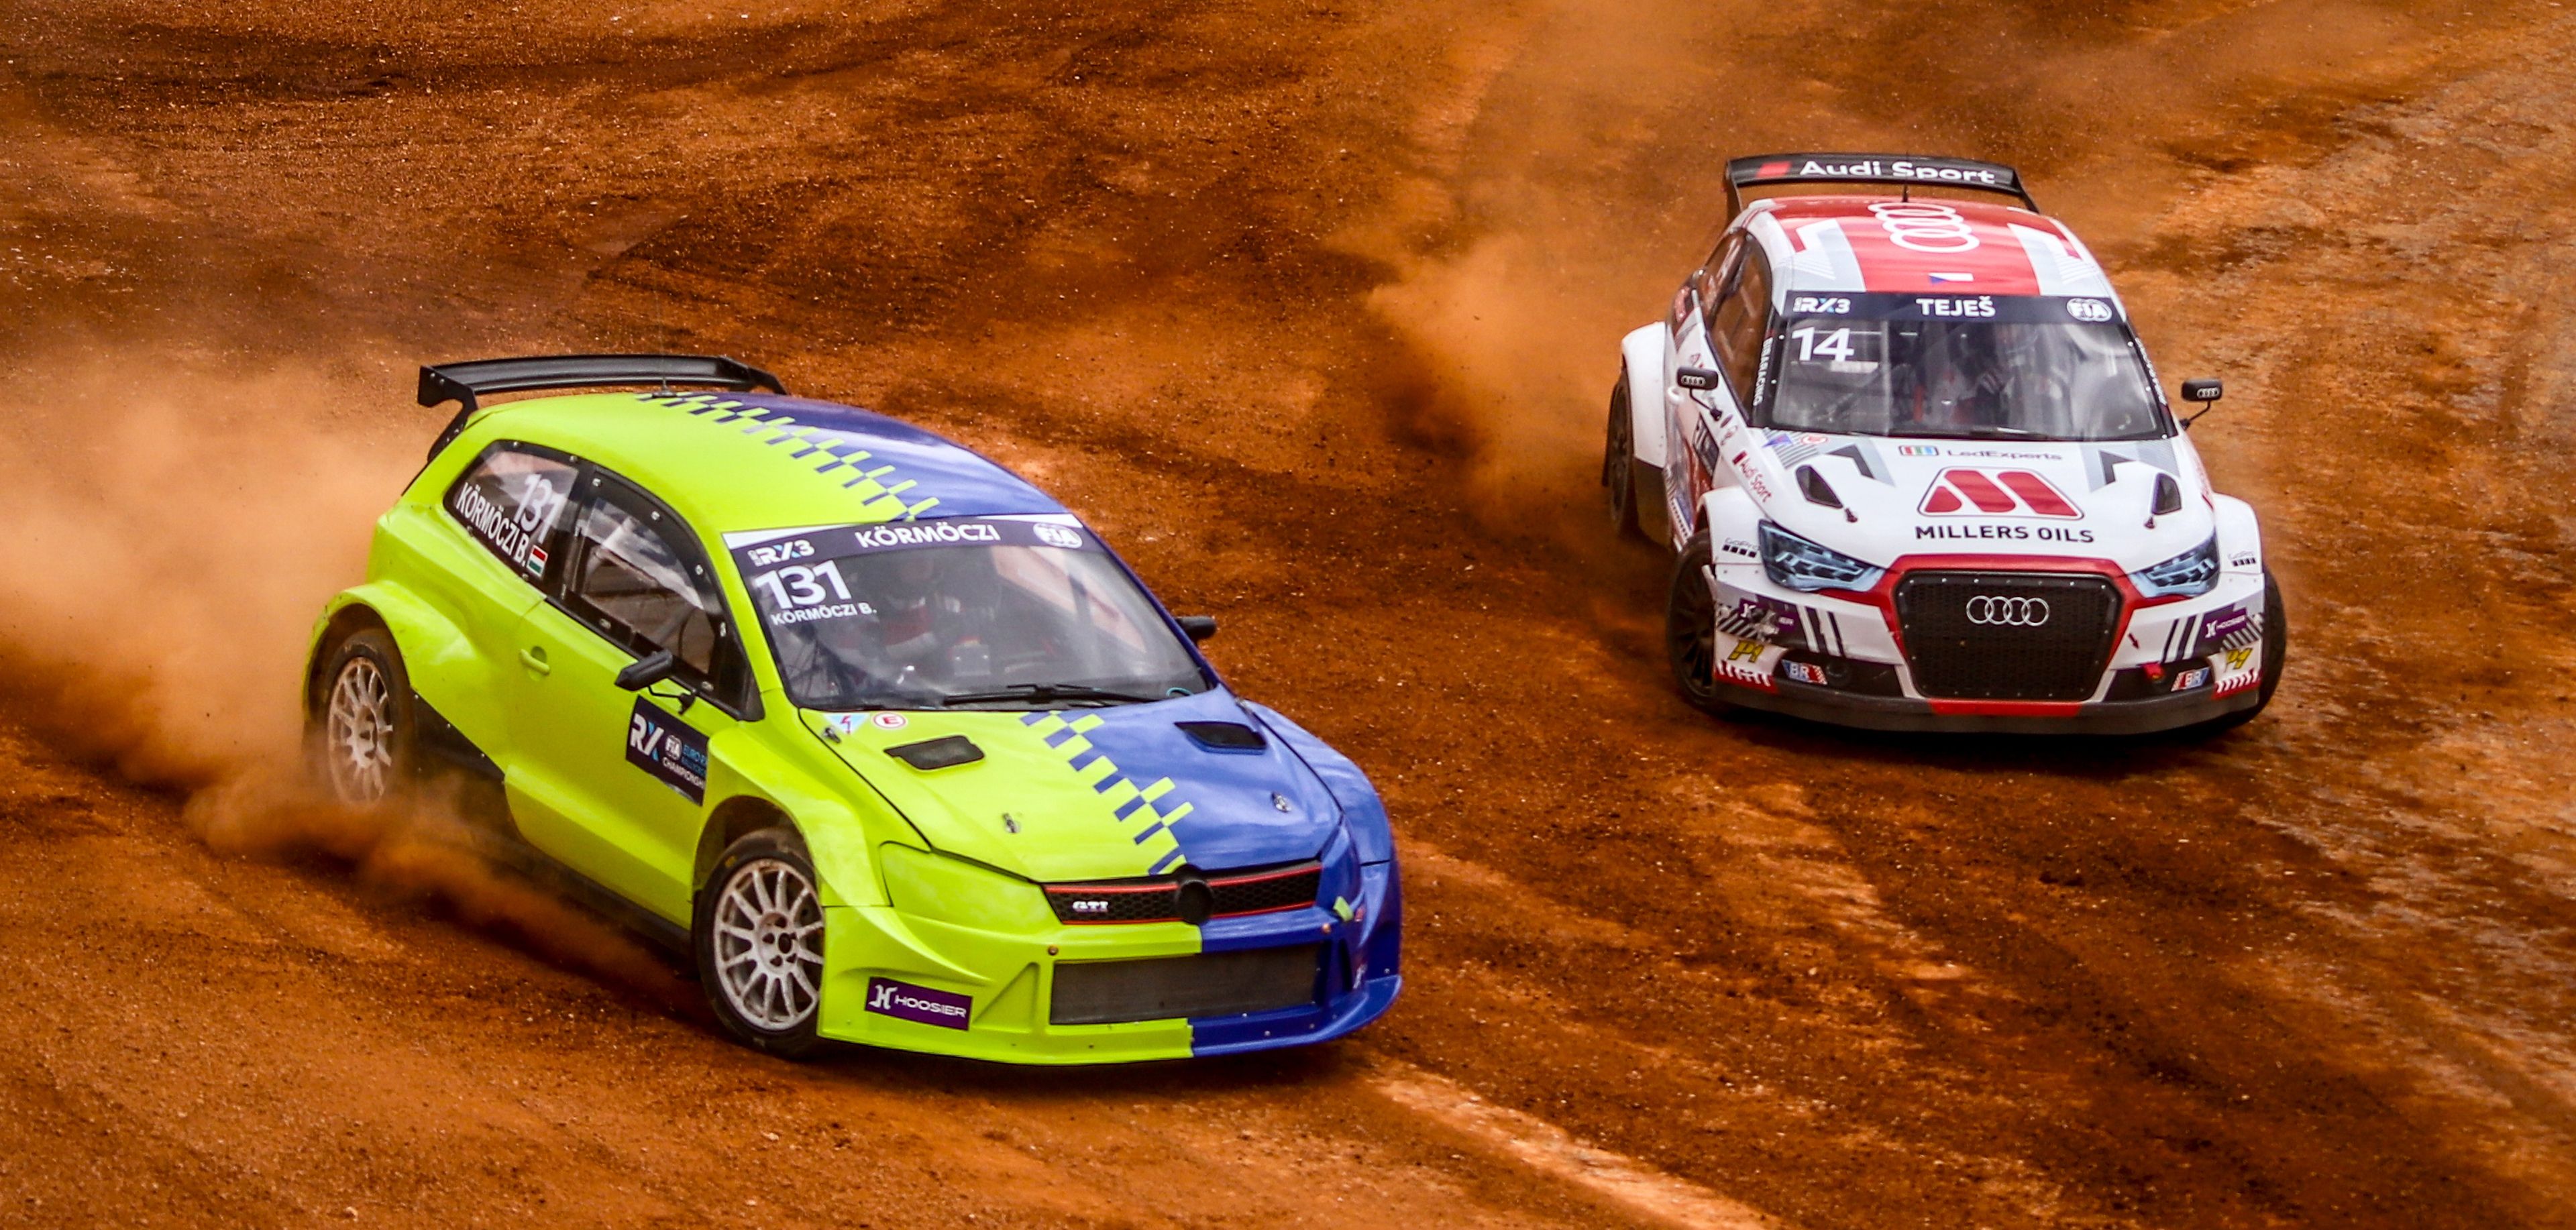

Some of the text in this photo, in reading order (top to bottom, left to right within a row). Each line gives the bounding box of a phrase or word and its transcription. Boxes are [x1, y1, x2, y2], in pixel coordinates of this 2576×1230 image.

[1800, 161, 1995, 184] Audi Sport
[1916, 296, 1996, 317] TEJEŠ
[2070, 301, 2108, 319] FIA
[1792, 327, 1854, 361] 14
[1947, 449, 2063, 460] LedExperts
[455, 482, 520, 555] KÖRMÖCZI
[514, 473, 562, 544] 131
[855, 522, 1001, 548] KÖRMÖCZI
[1038, 526, 1080, 547] FIA
[1916, 526, 2094, 543] MILLERS OILS
[755, 560, 852, 610] 131
[858, 602, 877, 615] B.
[631, 713, 665, 761] RX
[1073, 901, 1108, 912] GTI
[894, 995, 967, 1018] HOOSIER
